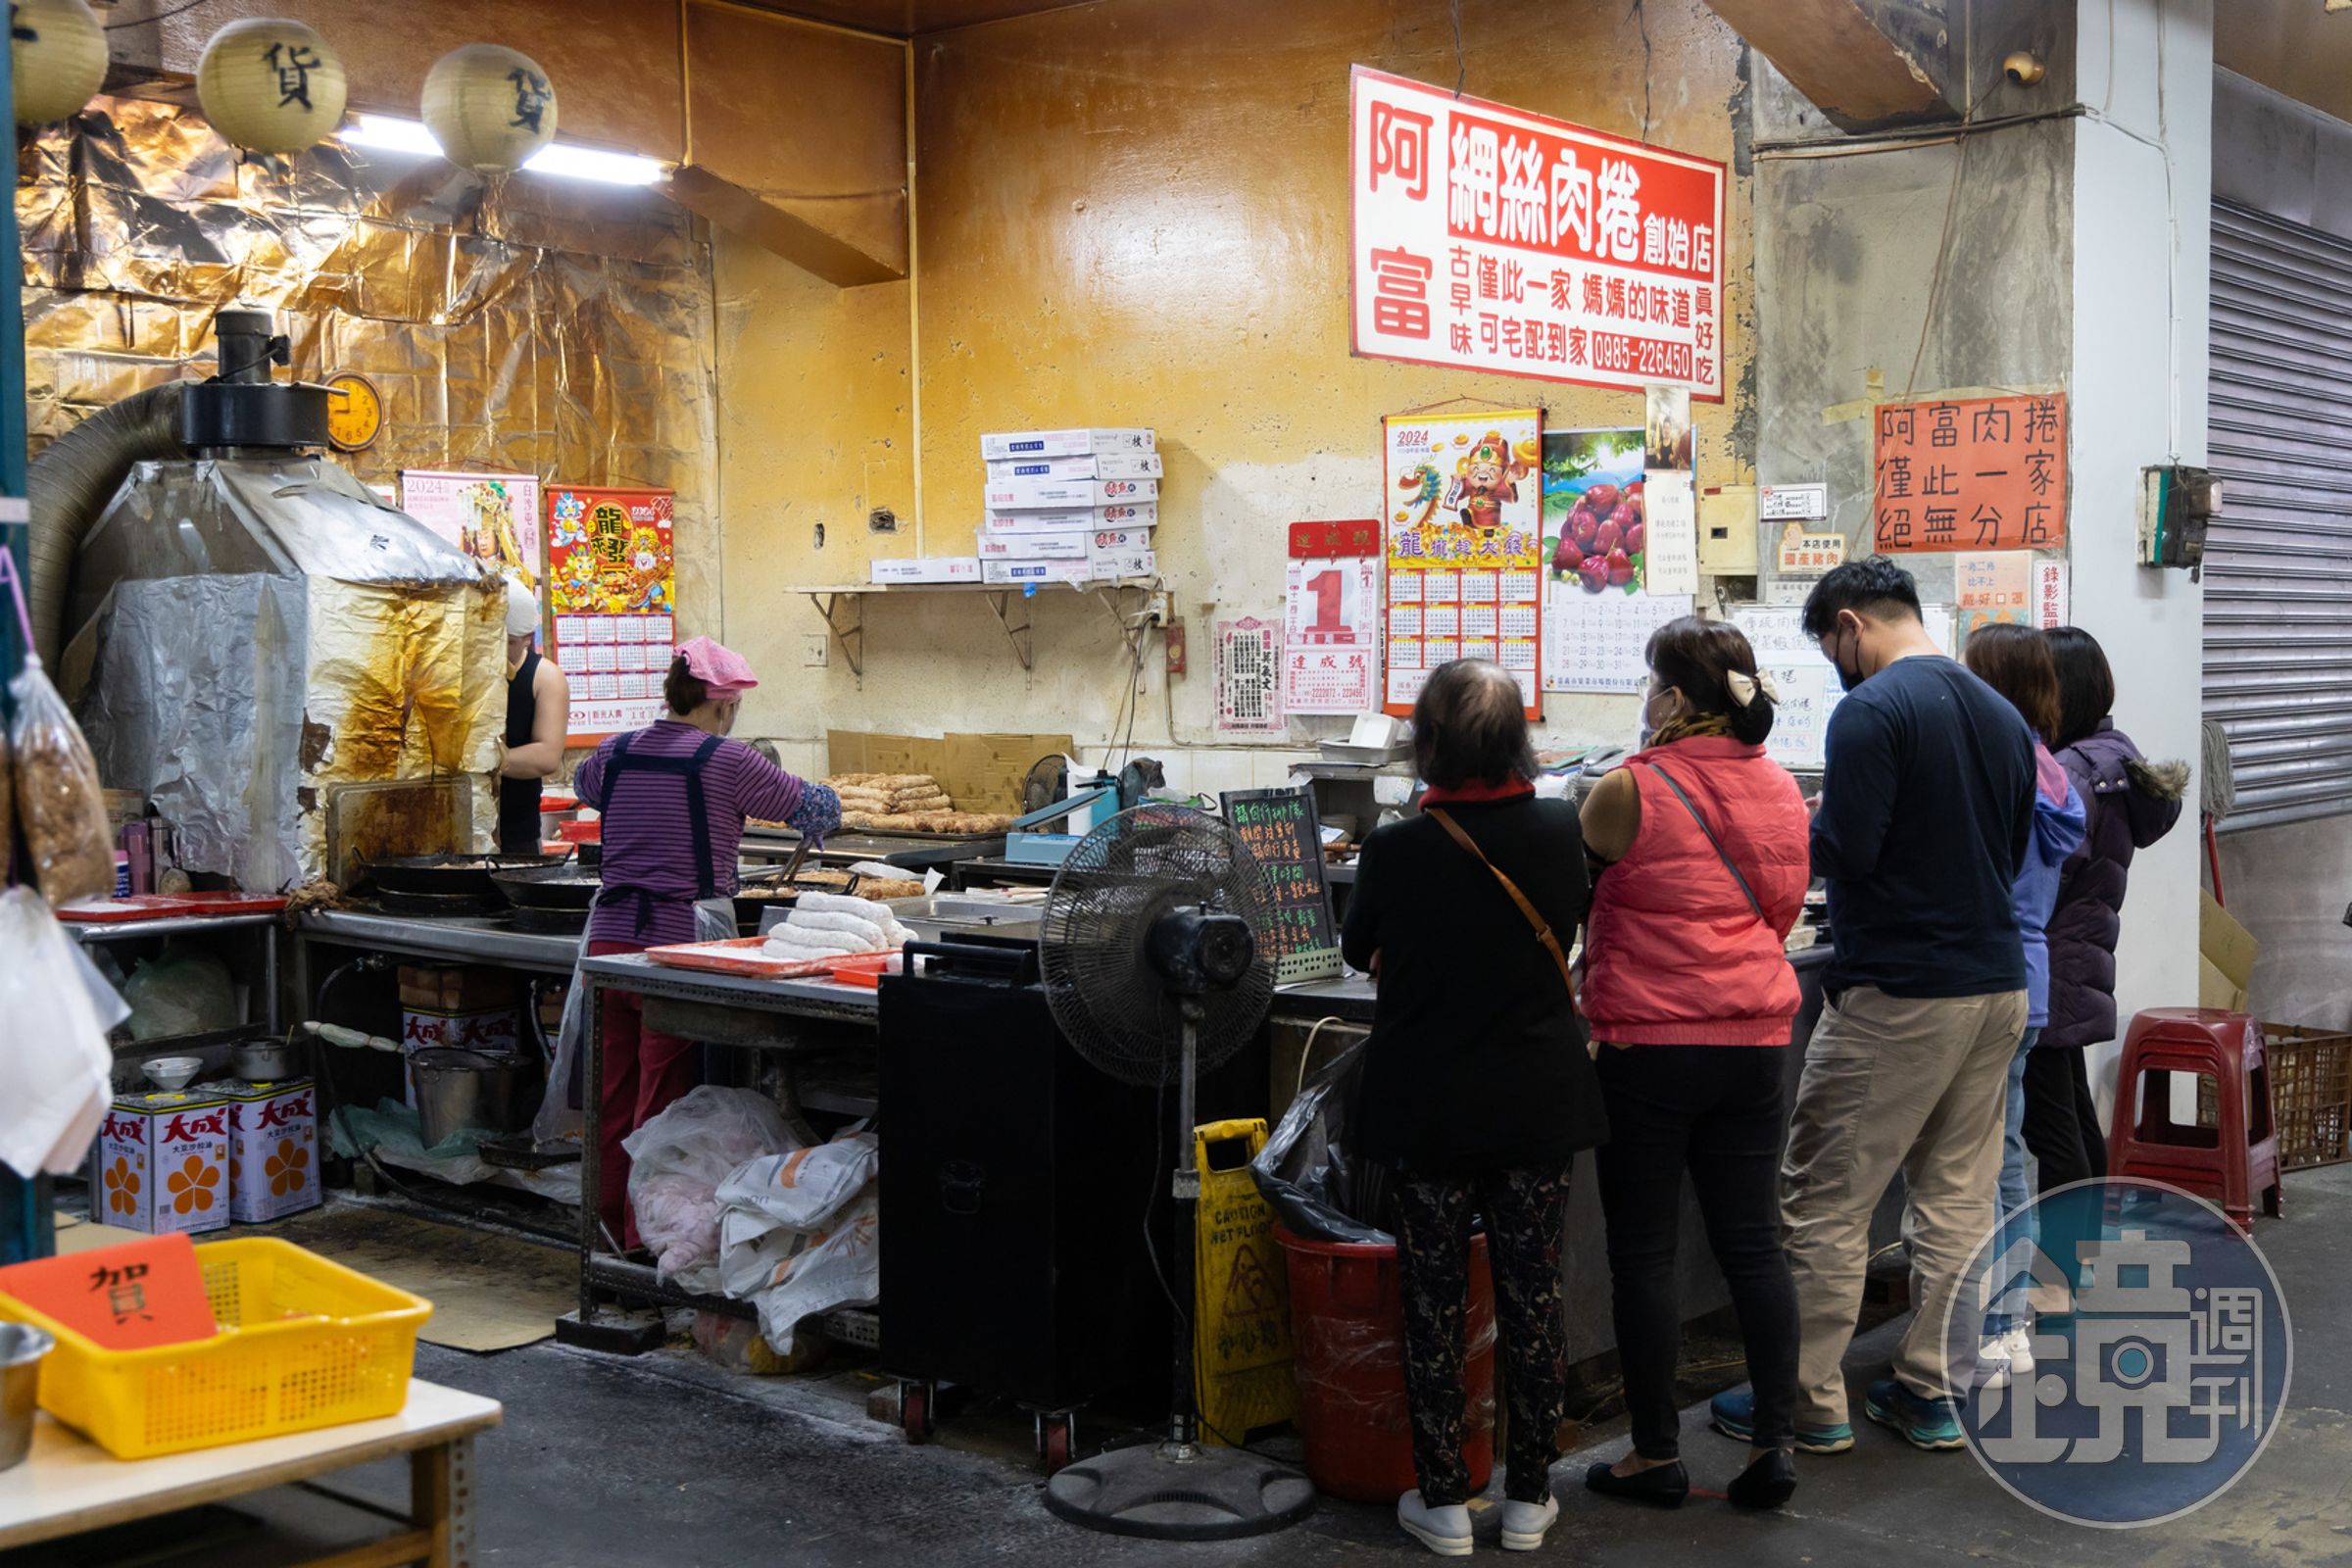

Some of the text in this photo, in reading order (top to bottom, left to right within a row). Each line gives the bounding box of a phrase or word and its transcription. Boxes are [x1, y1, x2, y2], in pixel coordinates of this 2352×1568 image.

[263, 42, 321, 114] 貨
[1449, 122, 1642, 264] 網絲肉捲
[1370, 99, 1434, 340] 阿富
[1642, 212, 1714, 274] 創始店
[1448, 245, 1474, 356] 古早味
[1476, 254, 1691, 329] 僅此一家 媽媽的味道
[1478, 312, 1690, 378] 可宅配到家 0985-226450
[1397, 430, 1429, 445] 2024
[1881, 399, 2059, 448] 阿富肉捲
[407, 479, 442, 494] 2024
[1878, 449, 2055, 499] 僅此一家
[1803, 539, 1841, 549] 本店使用
[1877, 501, 2051, 549] 絕無分店
[1304, 569, 1352, 632] 1
[102, 1111, 147, 1146] 大成
[161, 1107, 229, 1144] 大成
[256, 1090, 315, 1130] 大成
[172, 1142, 214, 1154] 大豆沙拉油
[88, 1262, 154, 1325] 賀
